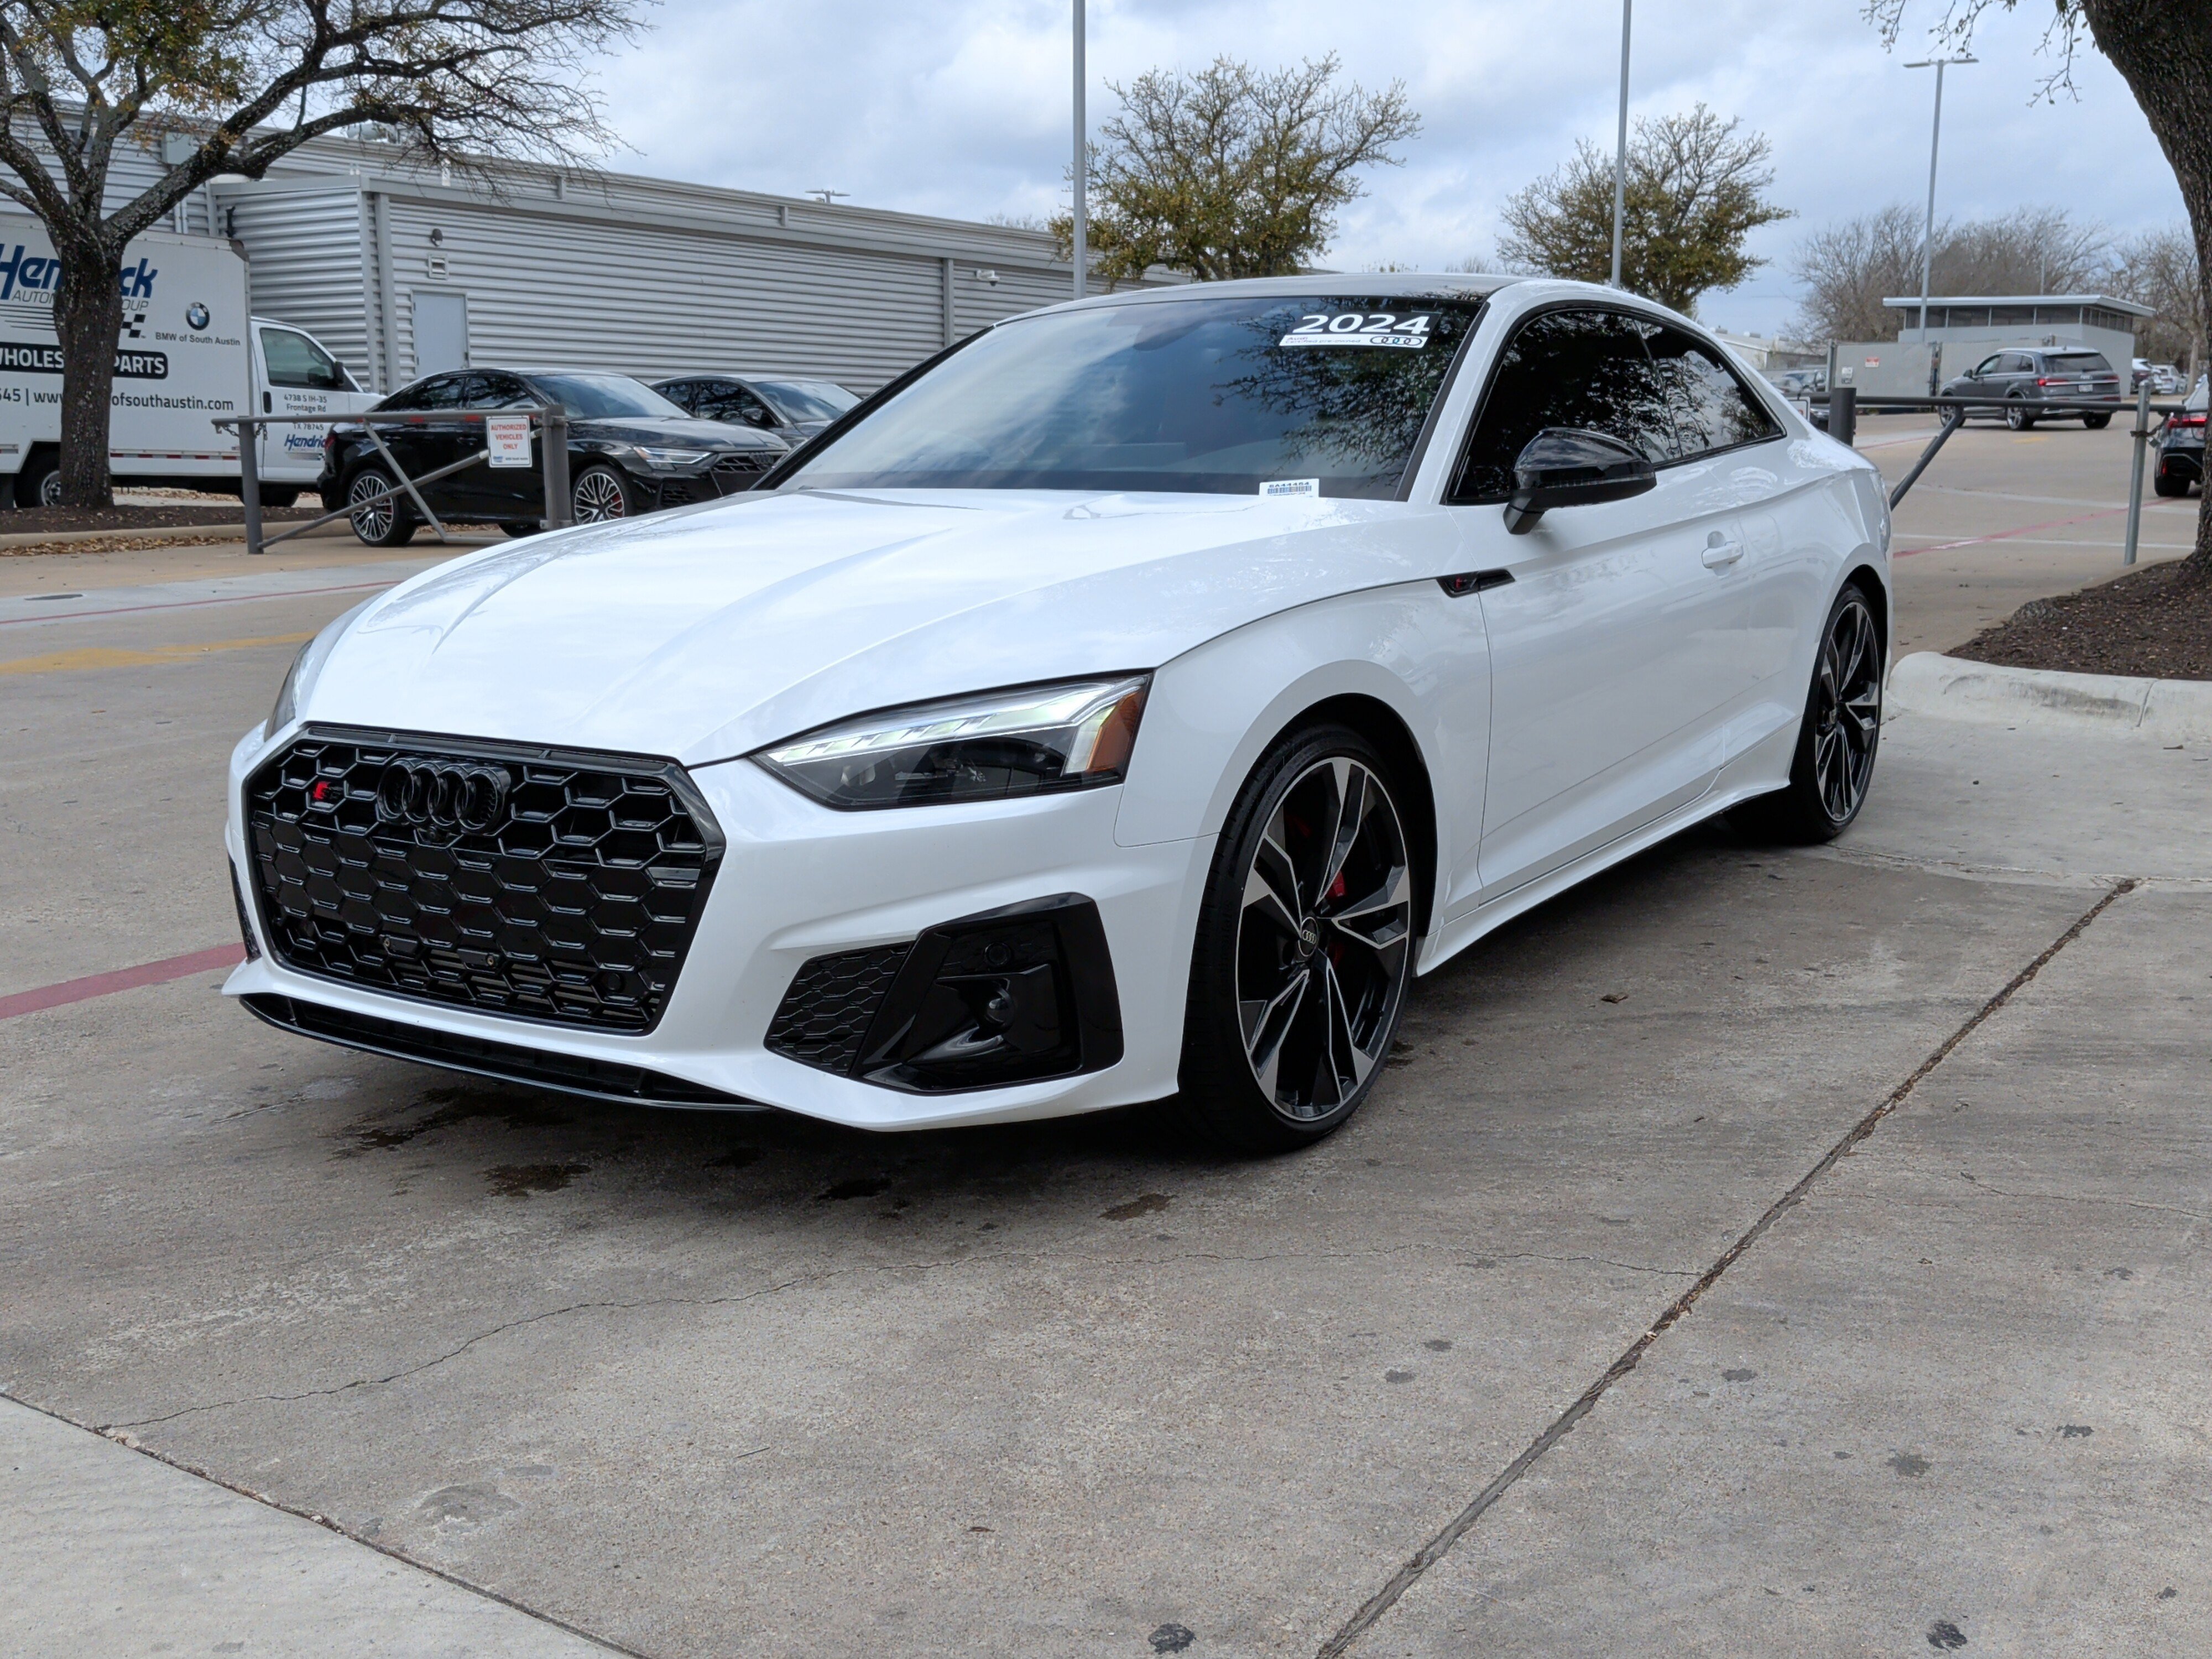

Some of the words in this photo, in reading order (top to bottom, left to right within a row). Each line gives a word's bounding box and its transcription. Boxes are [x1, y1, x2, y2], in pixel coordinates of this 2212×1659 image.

[1292, 314, 1430, 335] 2024
[155, 332, 177, 342] BMW
[189, 335, 213, 344] South
[215, 337, 241, 346] Austin
[113, 355, 165, 374] ARTS
[286, 403, 316, 413] Frontage
[284, 433, 326, 451] Hendric
